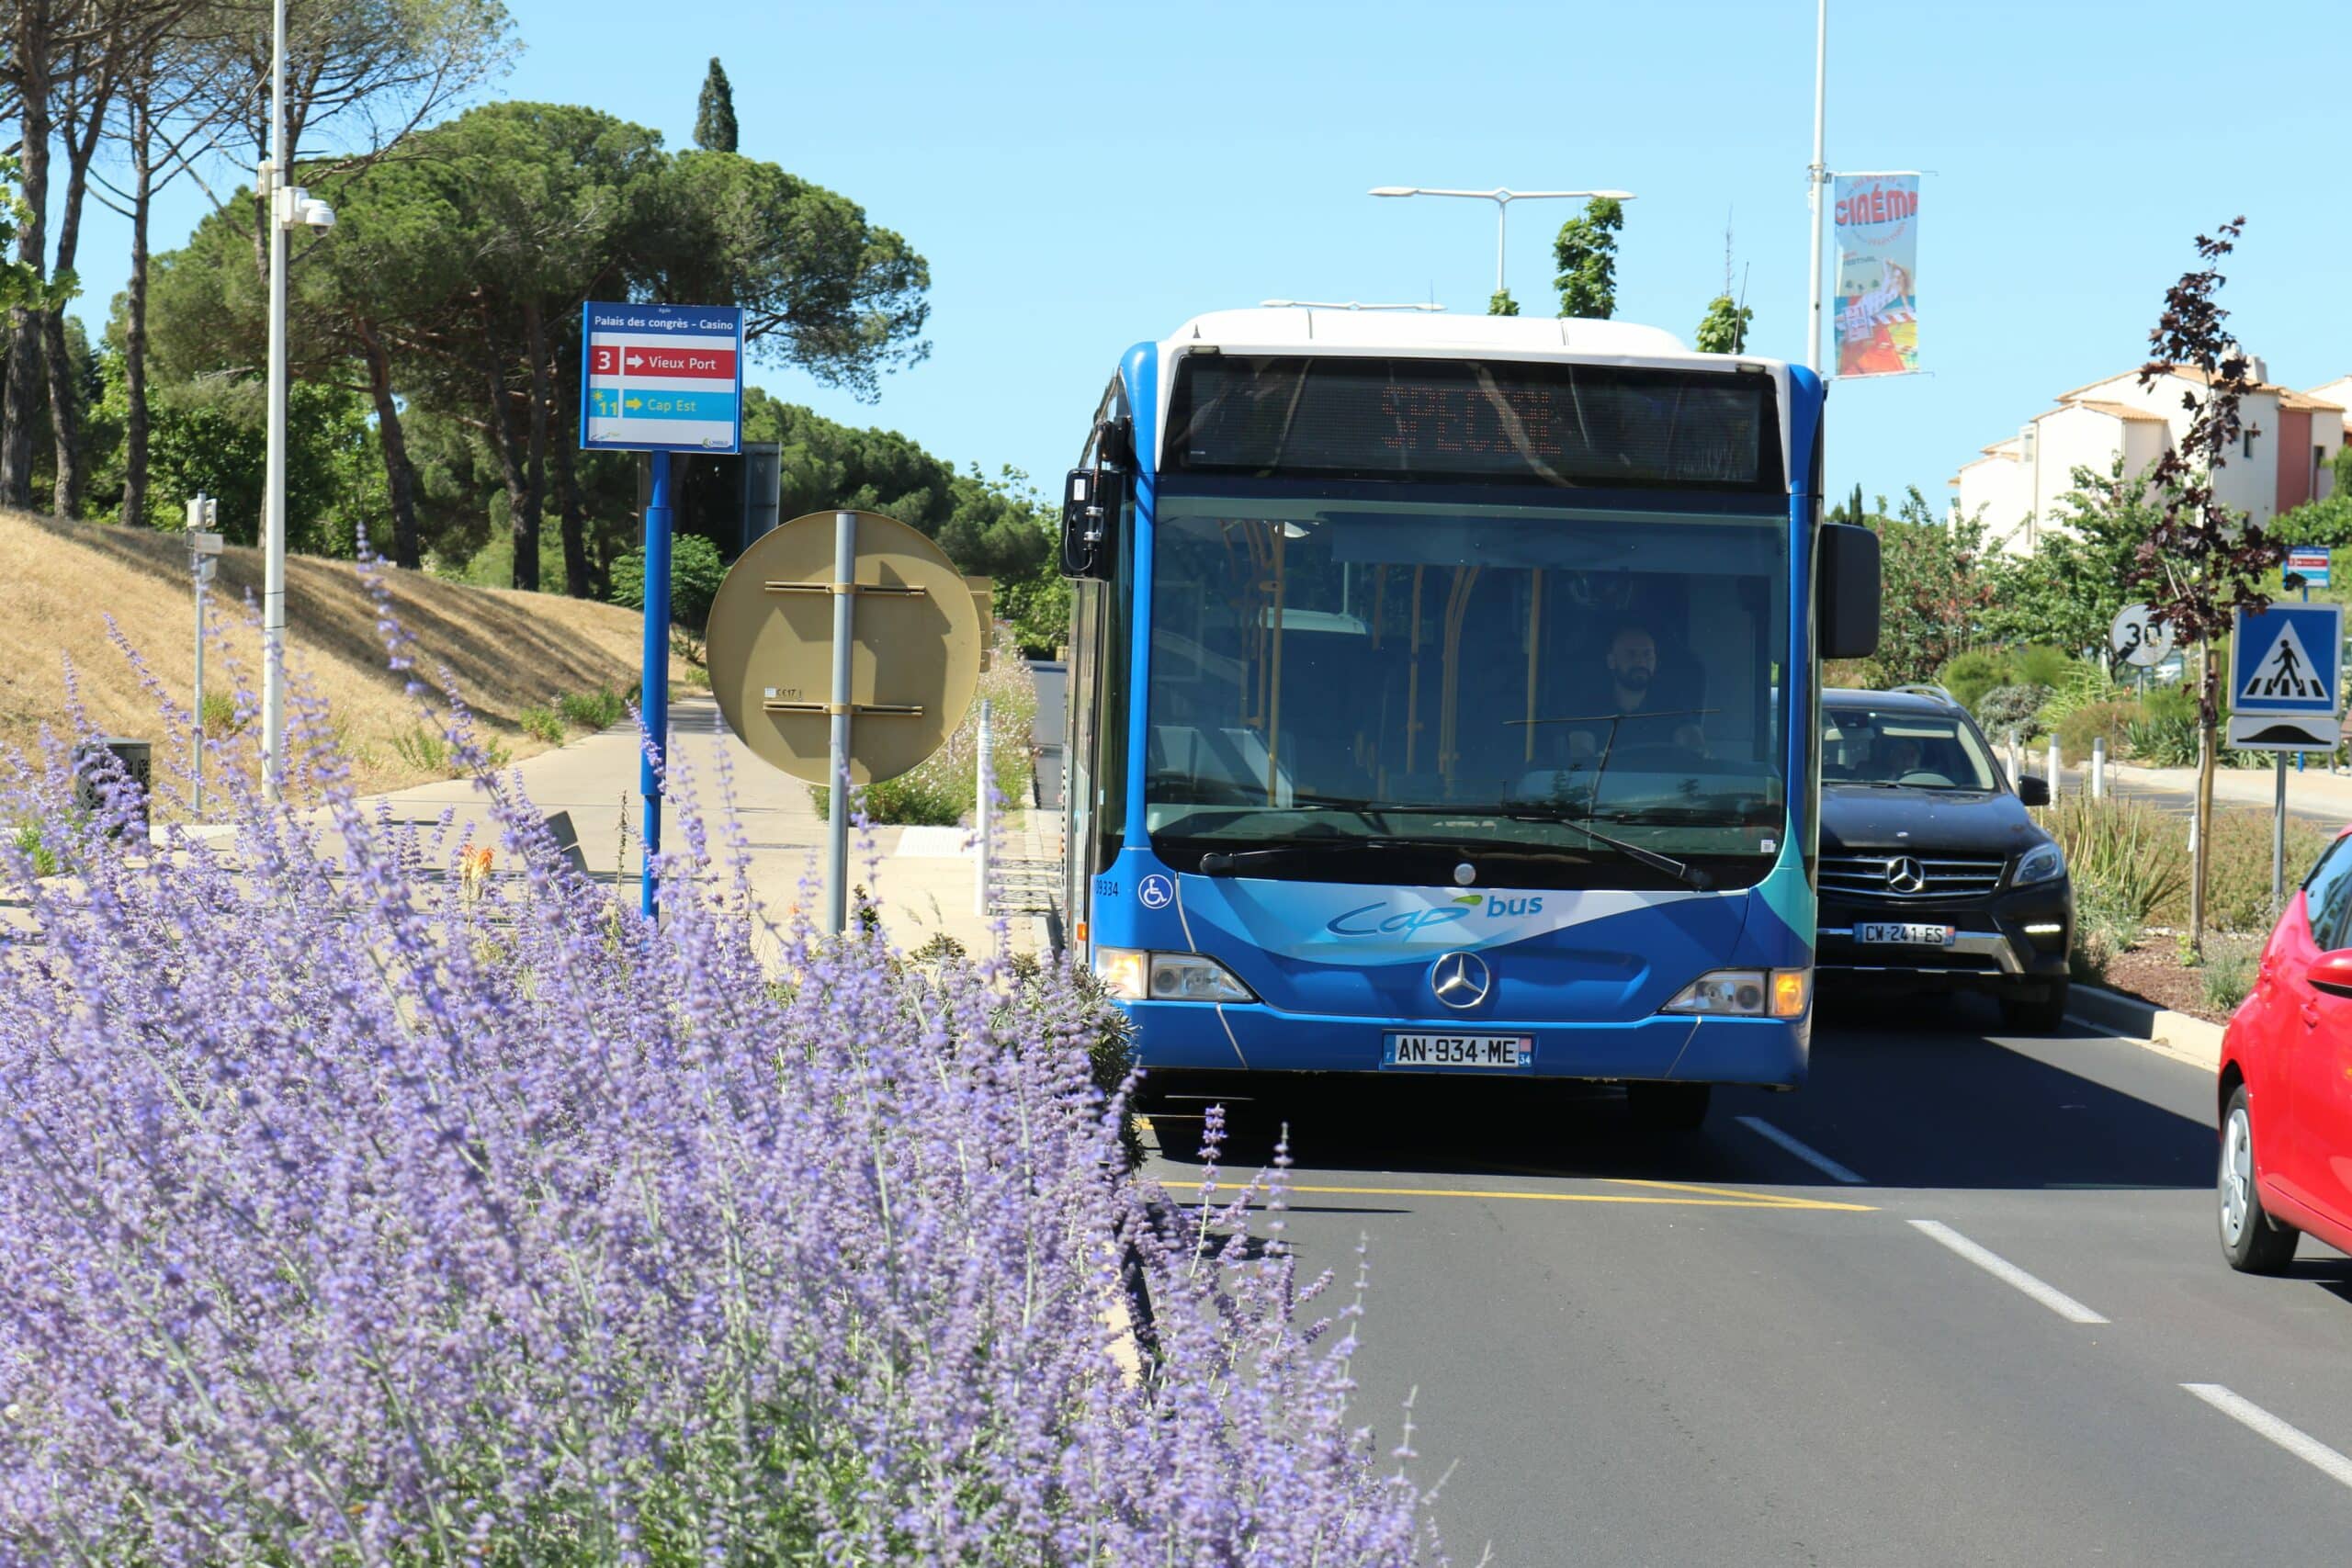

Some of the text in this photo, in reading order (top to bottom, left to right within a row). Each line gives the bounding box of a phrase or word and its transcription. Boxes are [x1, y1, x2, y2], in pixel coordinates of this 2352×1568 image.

[594, 315, 625, 326] Palais
[628, 316, 645, 327] des
[649, 317, 688, 330] congrès
[699, 319, 734, 330] Casino
[598, 351, 612, 370] 3
[649, 355, 717, 370] Vieux Port
[599, 401, 618, 415] 11
[648, 399, 696, 413] Cap Est
[2125, 622, 2162, 648] 30
[1327, 896, 1544, 943] Cap bus
[1865, 925, 1943, 943] CW-241-ES
[1398, 1038, 1517, 1064] AN-934-ME
[1519, 1055, 1531, 1065] 34
